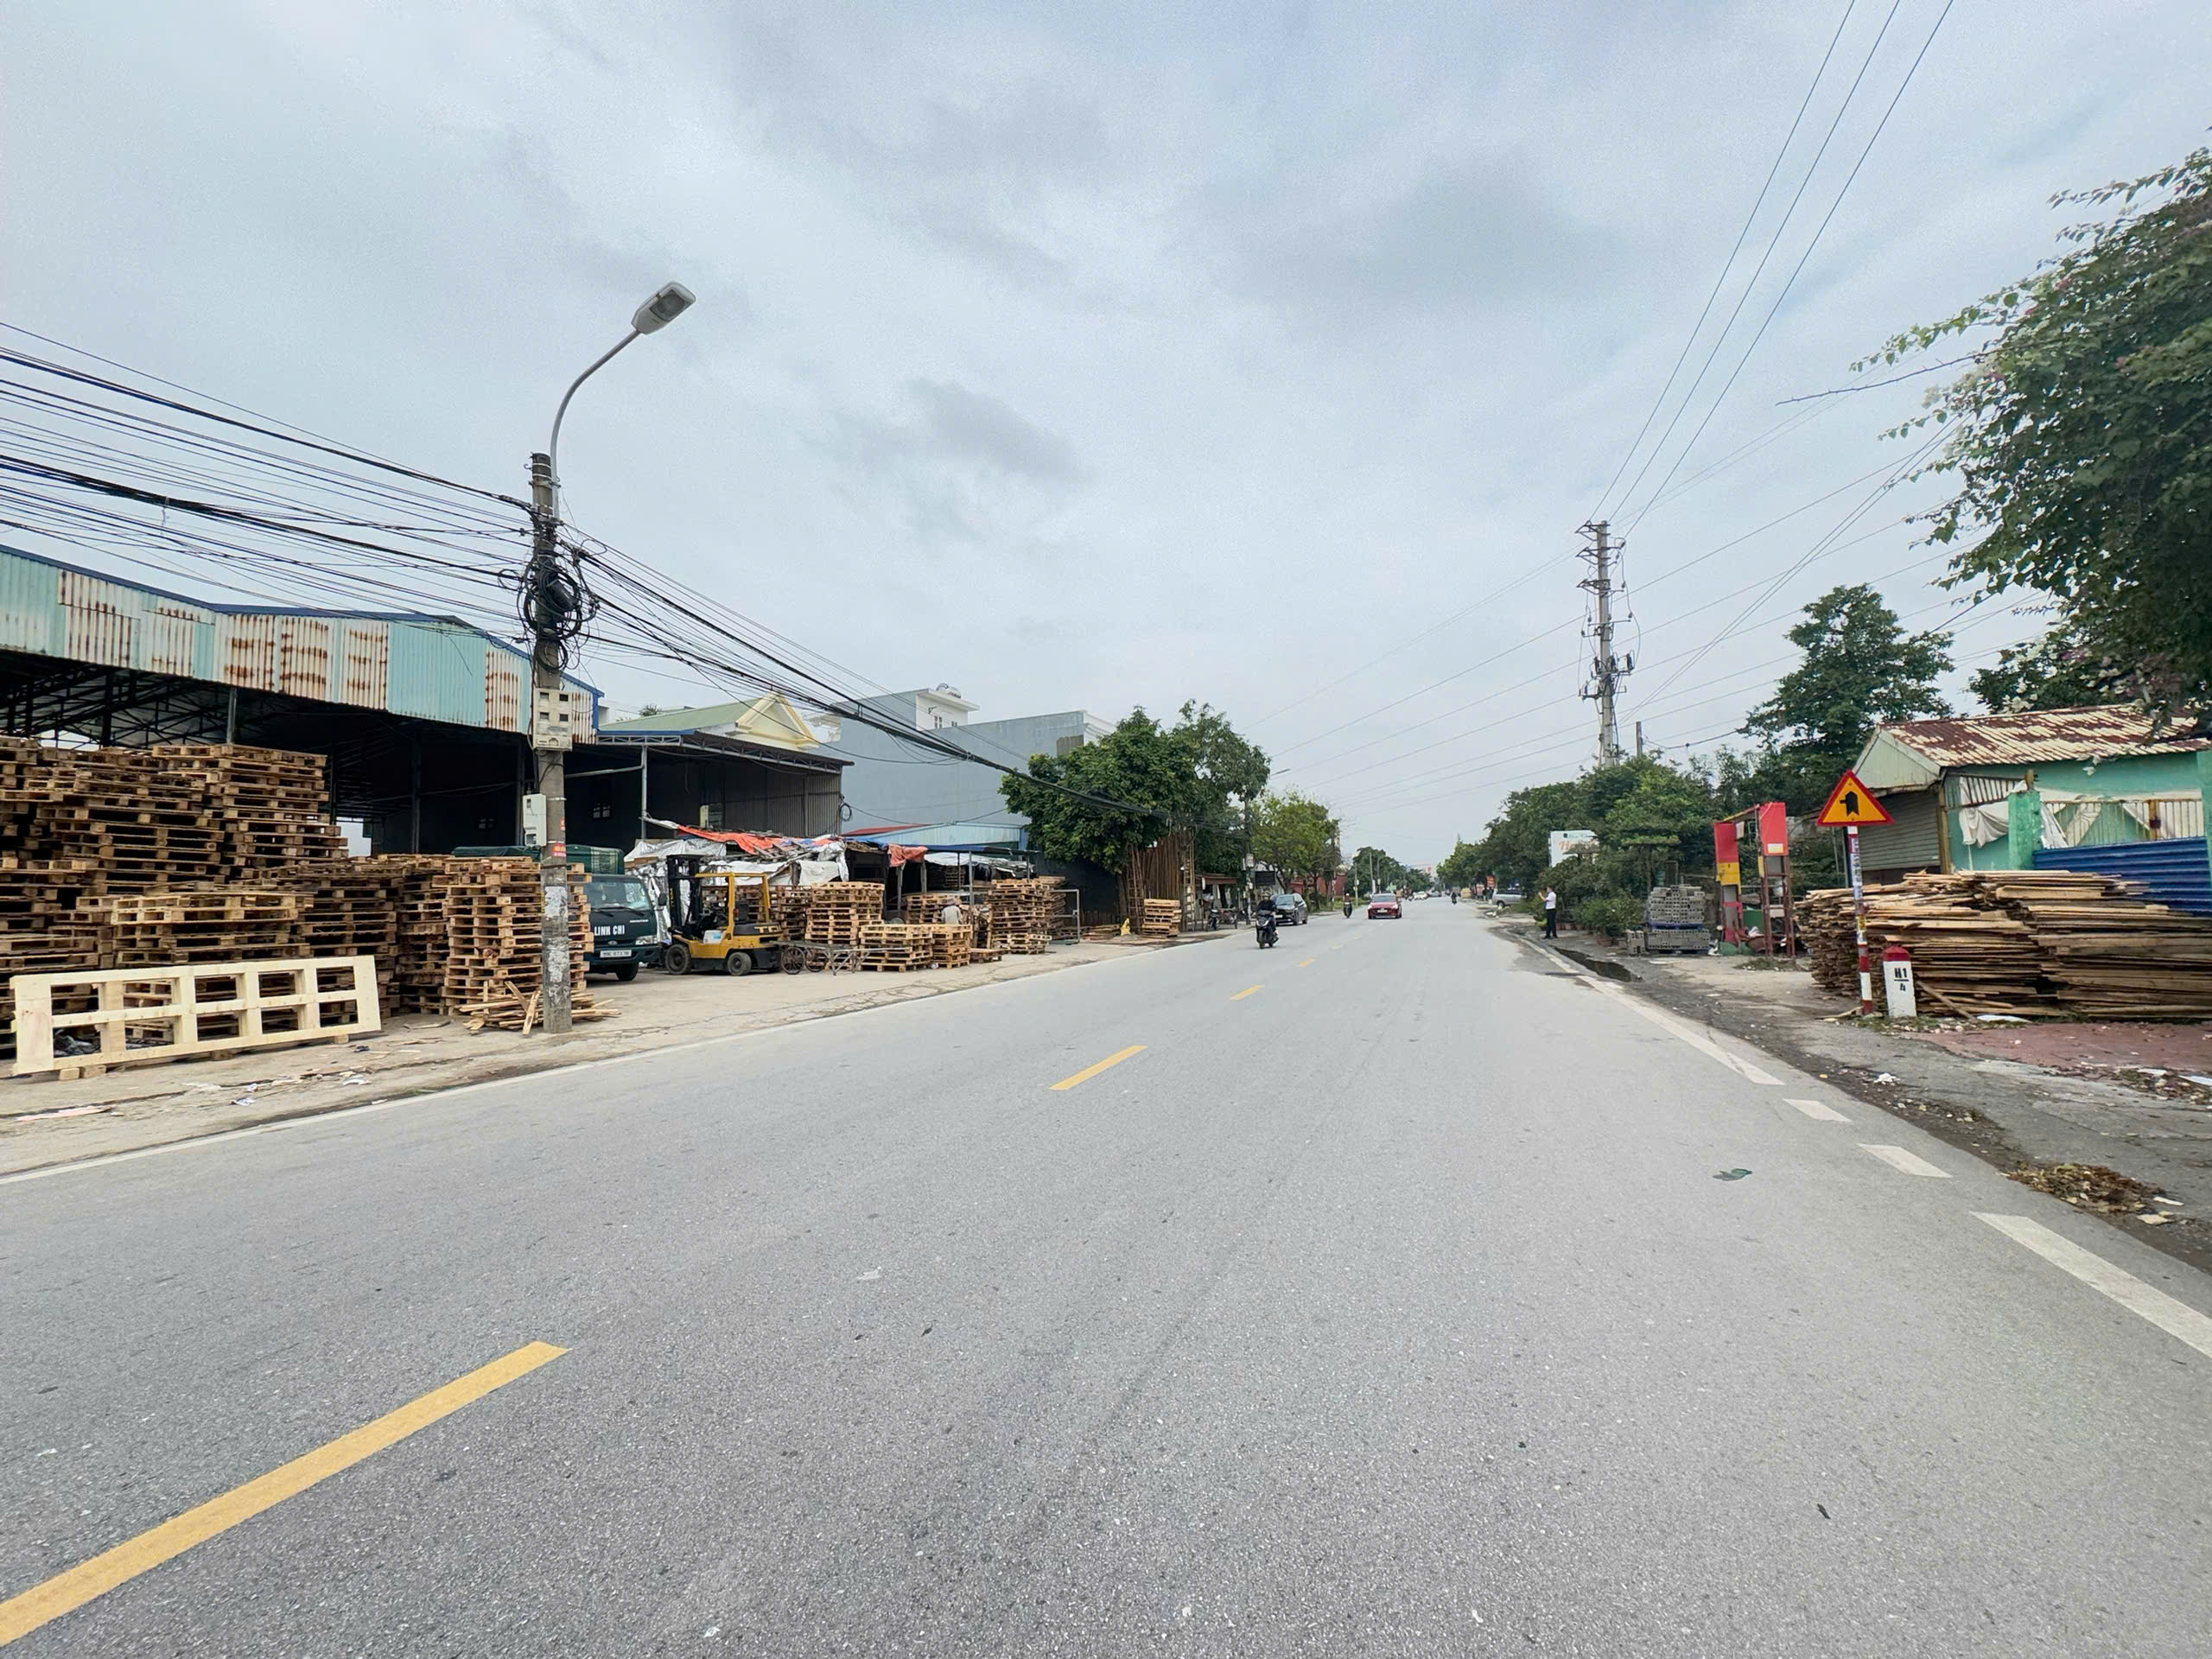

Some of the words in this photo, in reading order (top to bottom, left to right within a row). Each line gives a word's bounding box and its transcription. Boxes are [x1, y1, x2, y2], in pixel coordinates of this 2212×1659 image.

[594, 926, 611, 936] LINH
[613, 925, 626, 935] CHI
[1894, 968, 1907, 978] H1
